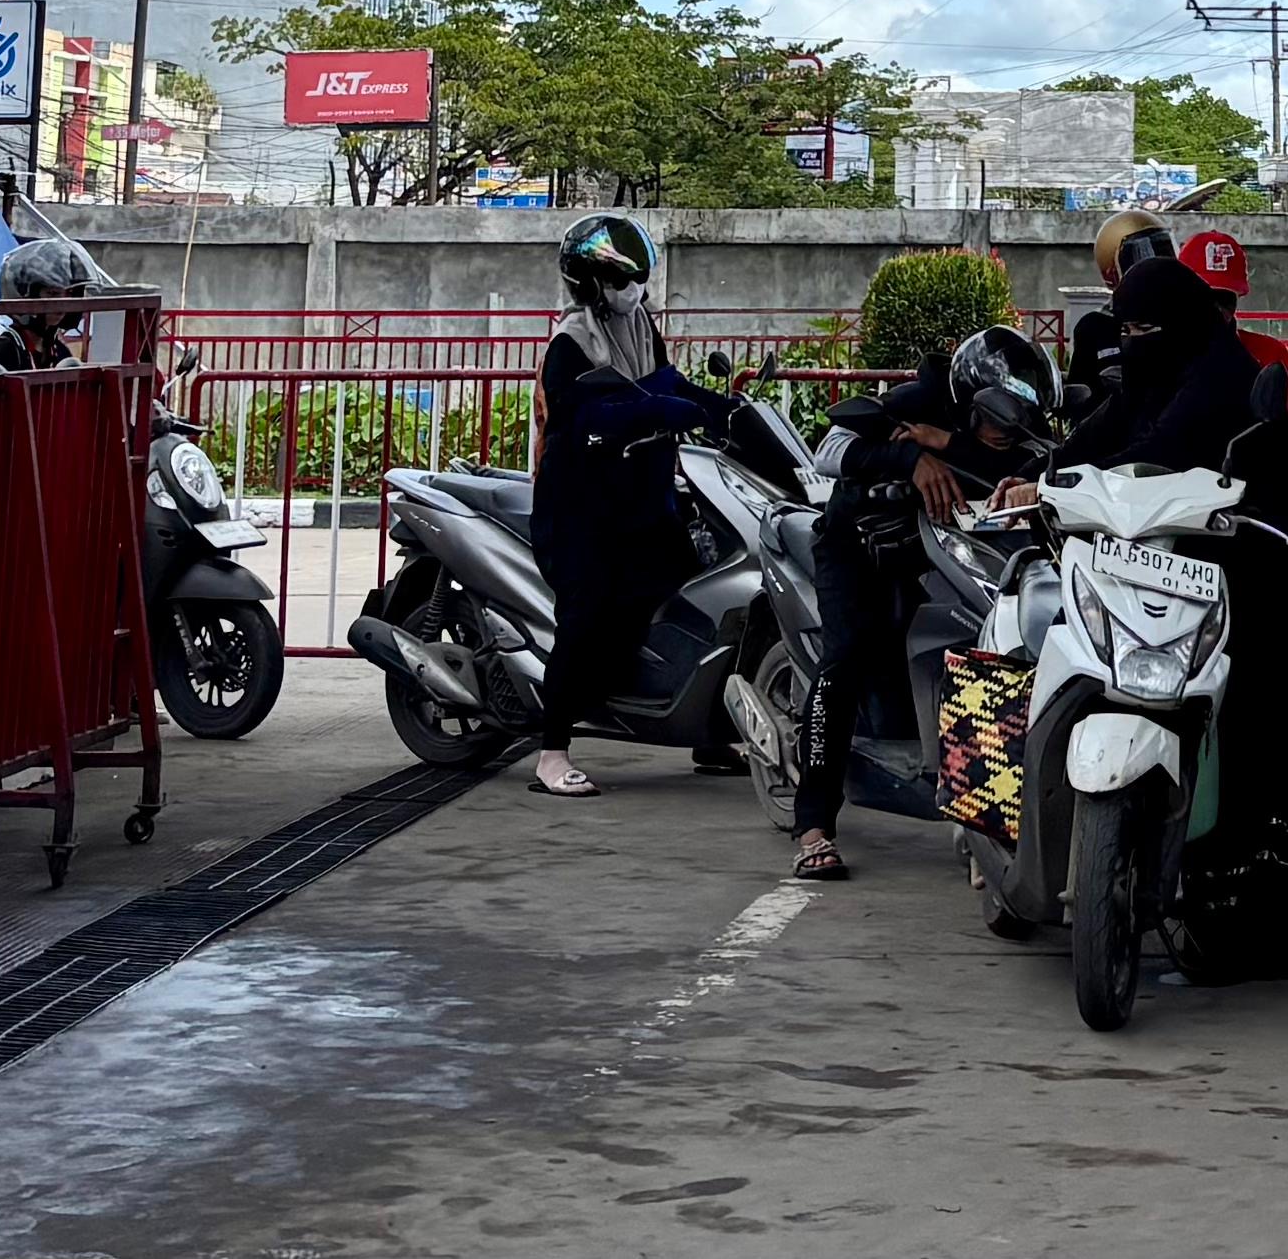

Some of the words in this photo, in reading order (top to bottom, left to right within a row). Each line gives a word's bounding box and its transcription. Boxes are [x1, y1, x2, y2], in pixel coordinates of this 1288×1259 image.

[305, 71, 373, 97] J&T
[361, 83, 409, 95] EXPRESS
[1100, 537, 1122, 561] DA
[1180, 562, 1214, 584] AHQ
